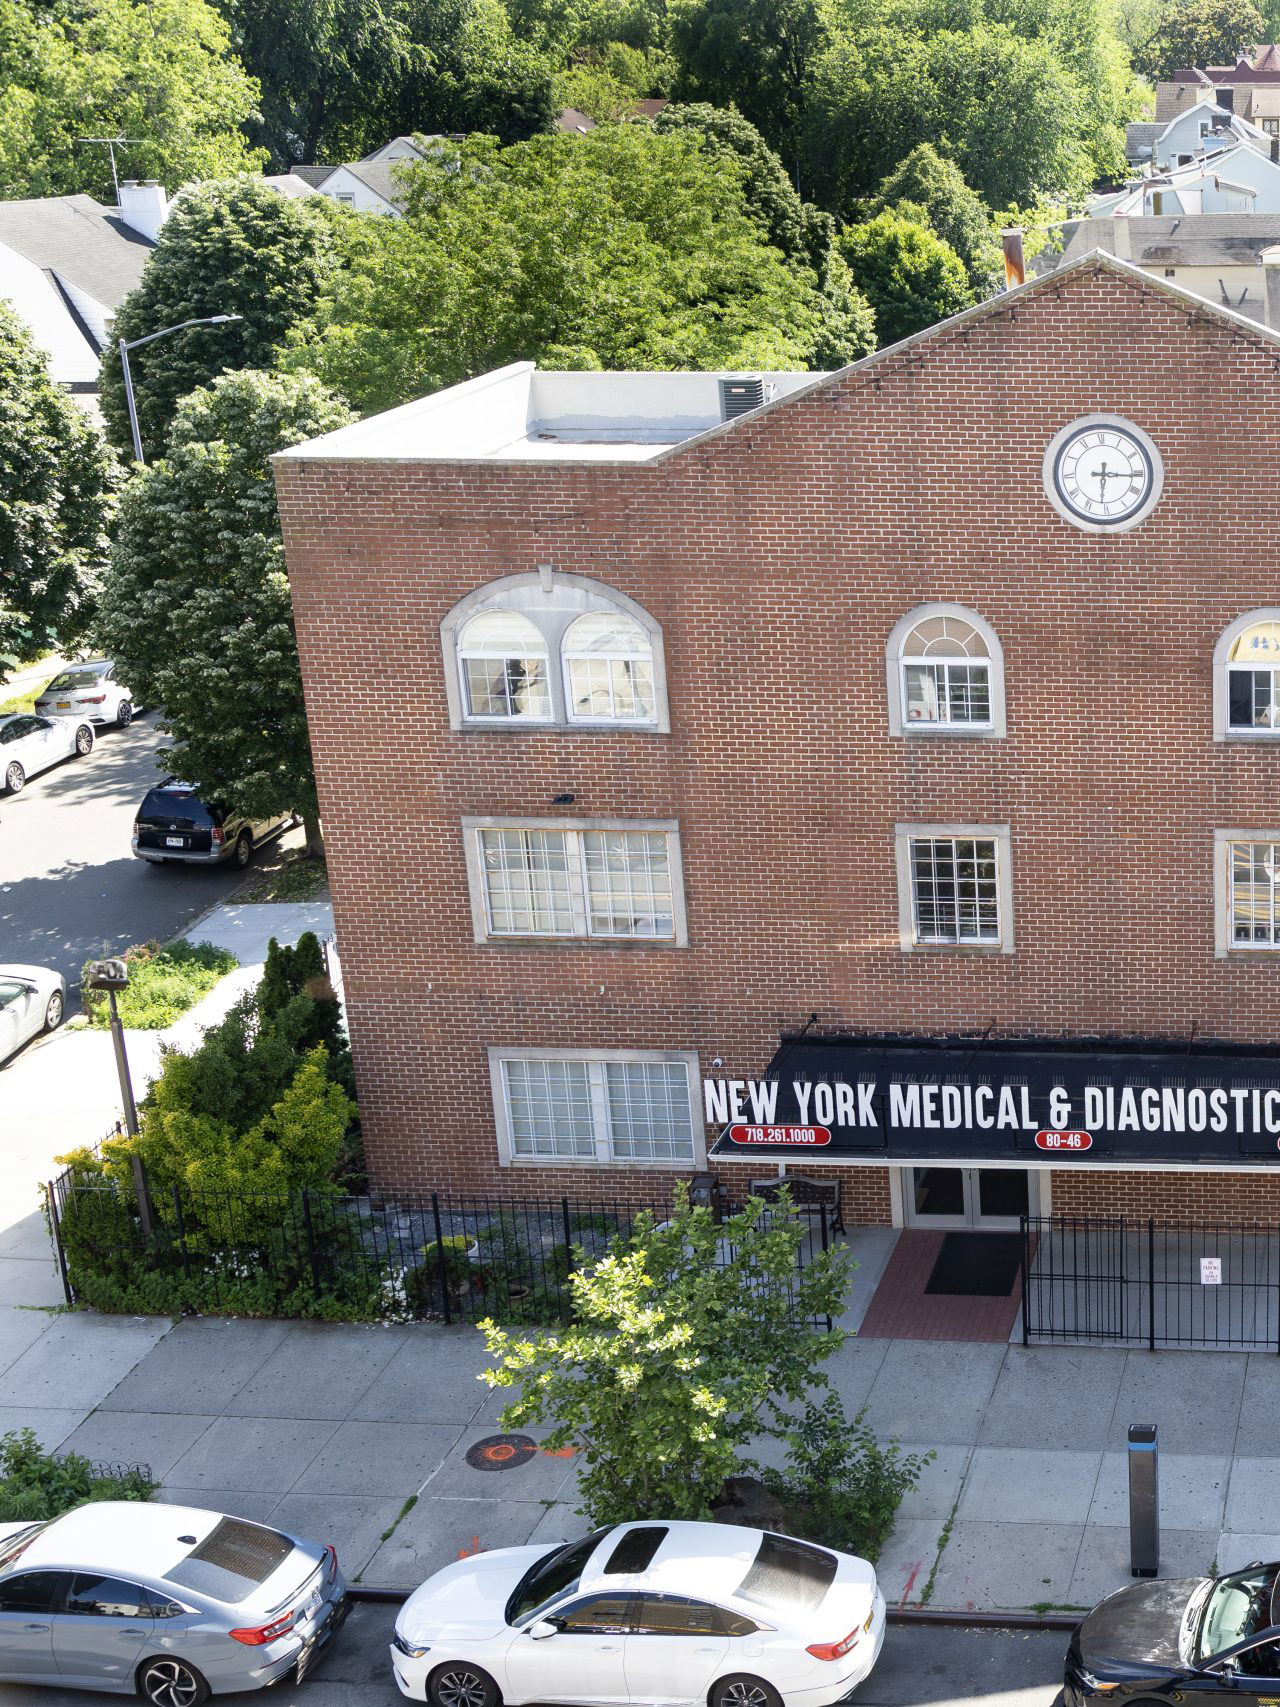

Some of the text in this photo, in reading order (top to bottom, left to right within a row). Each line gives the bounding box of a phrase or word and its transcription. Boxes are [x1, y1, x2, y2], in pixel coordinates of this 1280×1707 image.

[704, 1078, 778, 1125] NEW
[792, 1081, 878, 1127] YORK
[889, 1083, 1038, 1130] MEDICAL
[1050, 1086, 1072, 1130] &
[745, 1127, 815, 1143] 718.261.1000
[1046, 1133, 1081, 1147] 80-46
